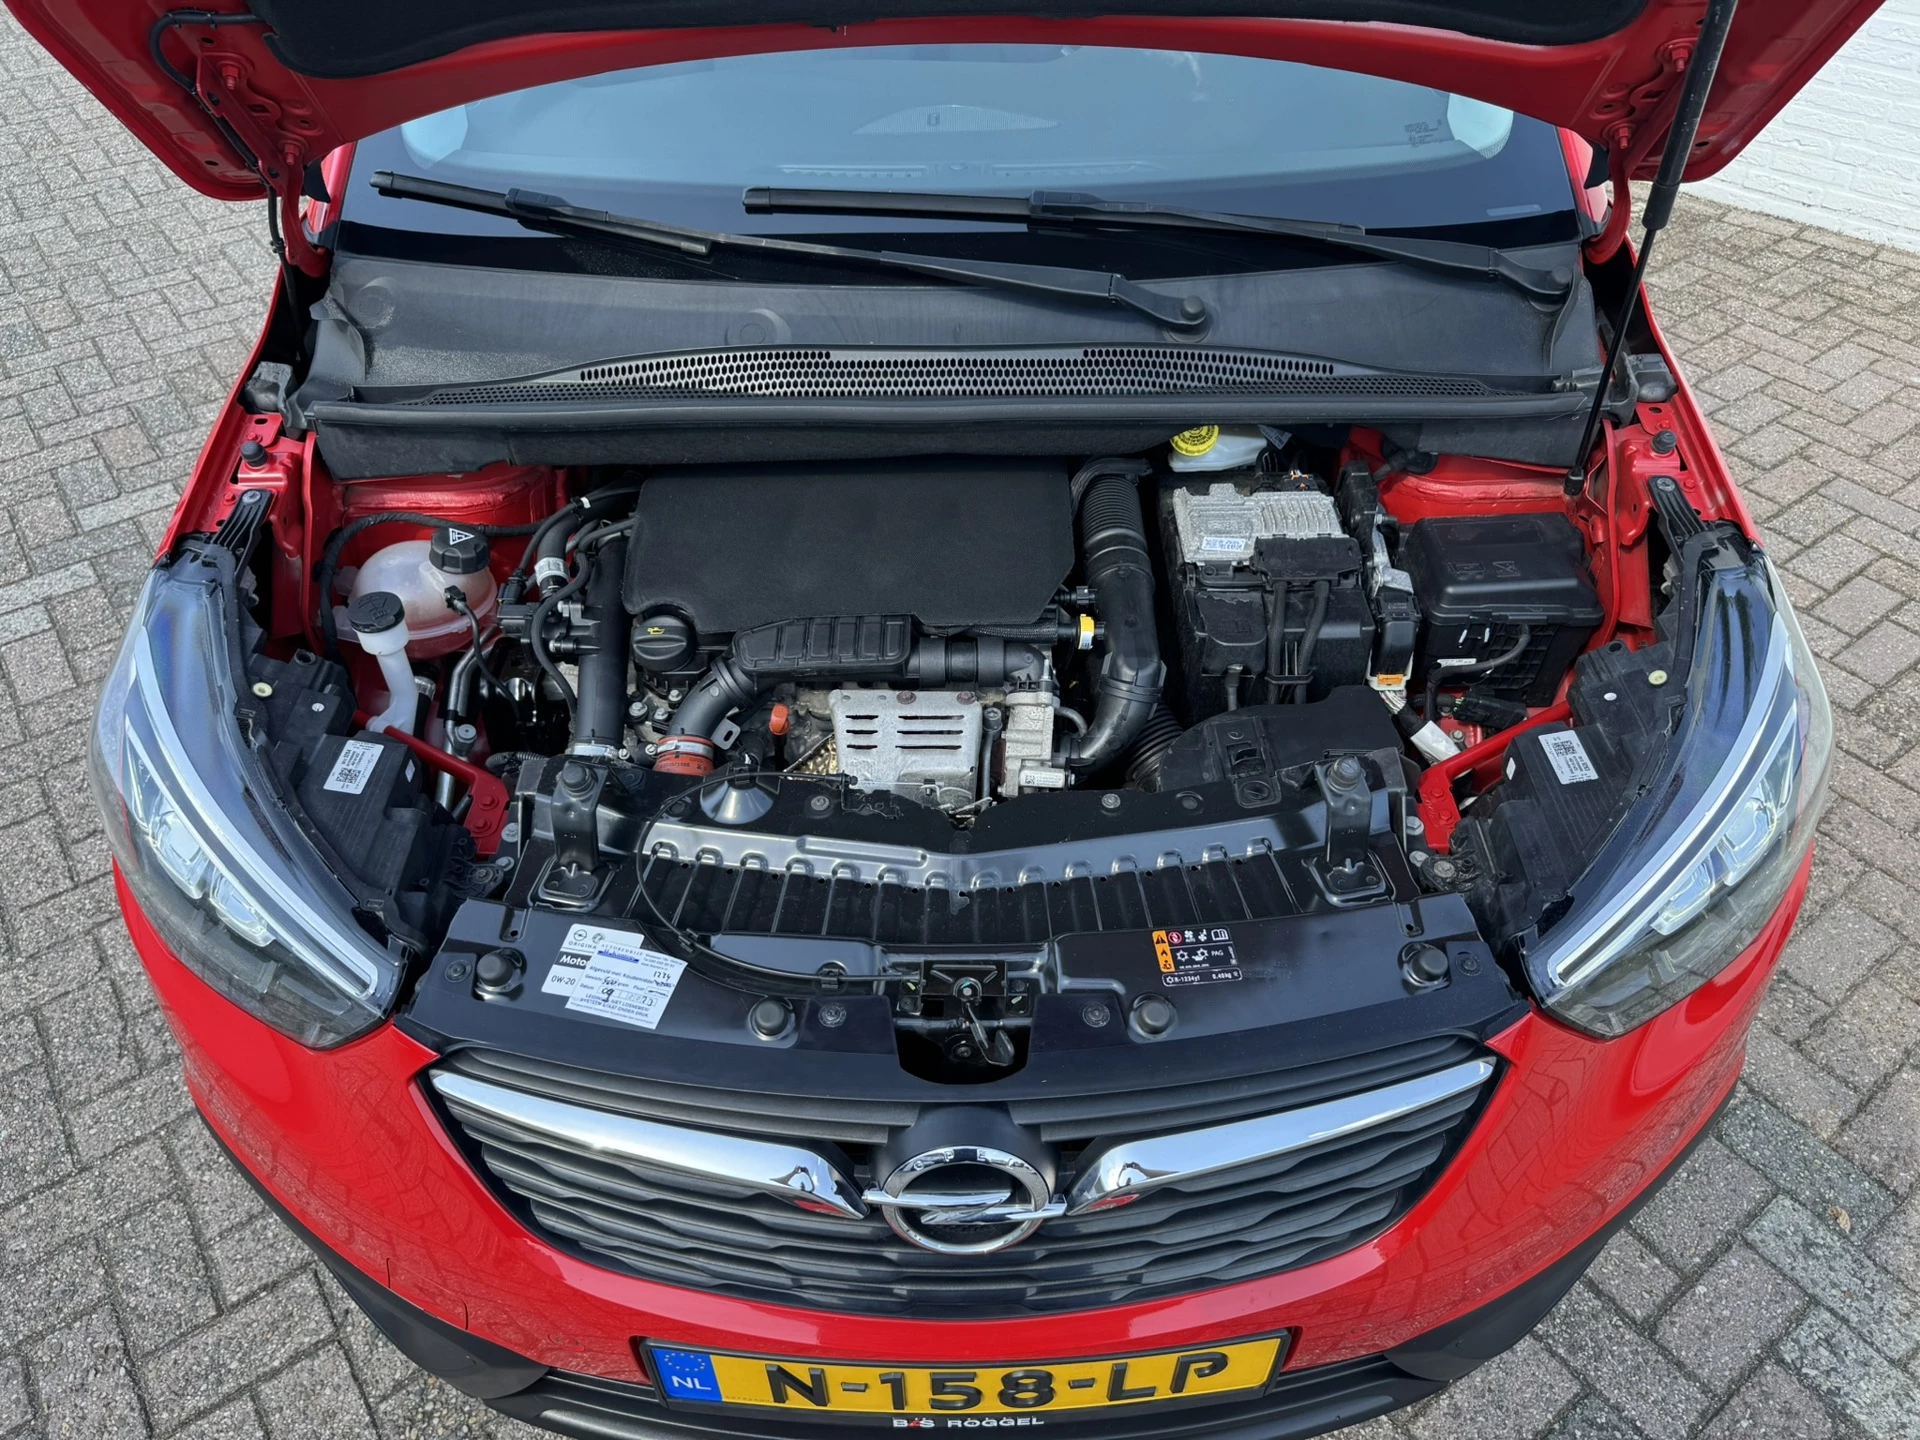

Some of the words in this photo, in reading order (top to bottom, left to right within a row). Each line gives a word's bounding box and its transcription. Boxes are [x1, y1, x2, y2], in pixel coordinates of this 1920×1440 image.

[568, 940, 597, 950] ORIGINA
[1211, 949, 1224, 957] PAG
[560, 954, 588, 967] Moto
[551, 975, 577, 986] 0W-20
[671, 1375, 712, 1391] NL
[764, 1351, 1229, 1411] N-158-LP
[947, 1415, 1045, 1428] ROGGEL
